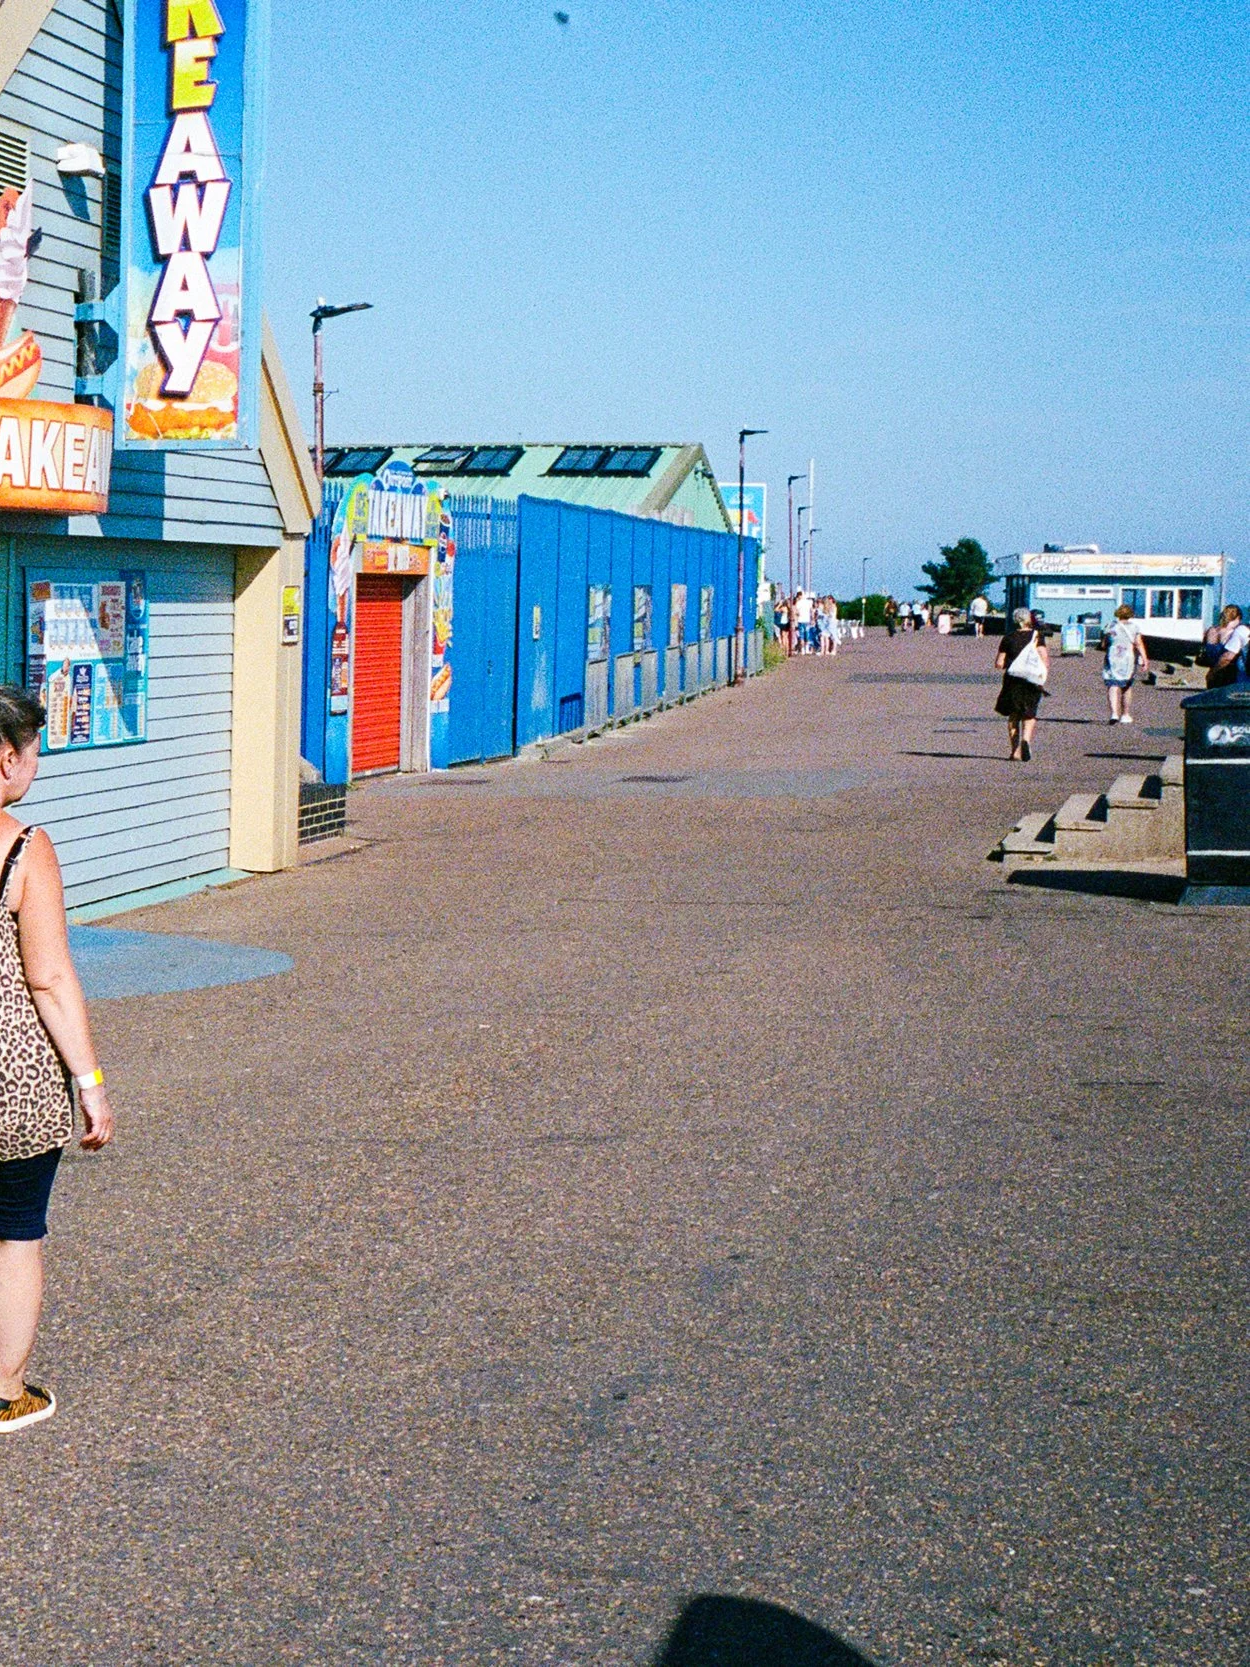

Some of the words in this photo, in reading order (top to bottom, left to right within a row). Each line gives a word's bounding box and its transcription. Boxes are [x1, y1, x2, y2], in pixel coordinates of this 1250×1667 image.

[1181, 555, 1199, 564] ICE
[1040, 564, 1070, 573] CHIPS
[1173, 564, 1208, 574] CREAM
